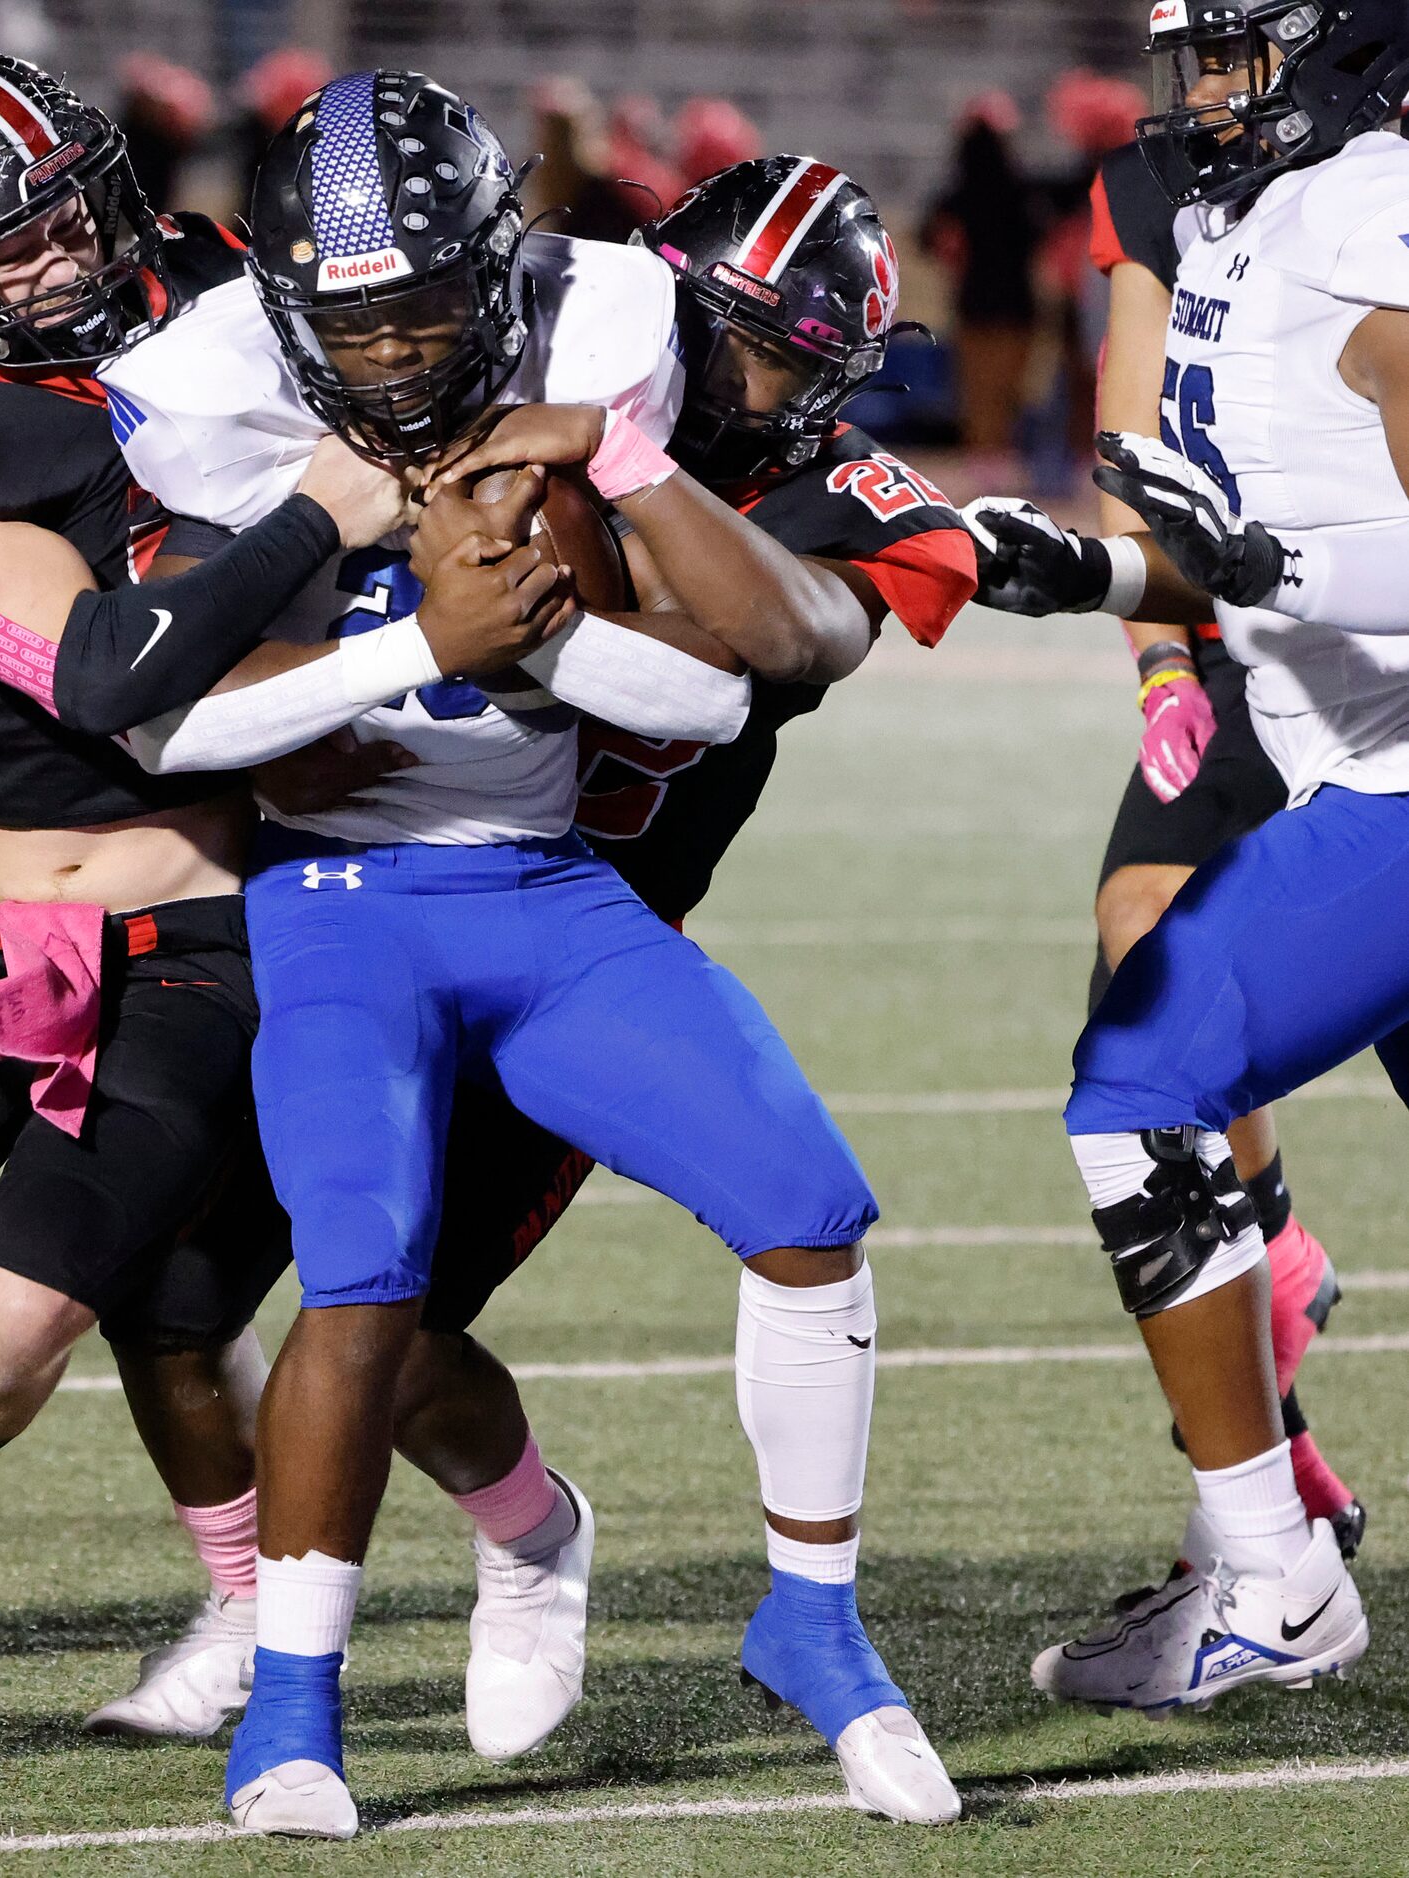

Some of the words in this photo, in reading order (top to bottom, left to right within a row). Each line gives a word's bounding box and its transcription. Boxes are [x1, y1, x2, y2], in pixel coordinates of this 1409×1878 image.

[27, 142, 85, 185] PANTHERS
[327, 254, 396, 280] Riddell
[712, 263, 782, 307] PANTHERS
[1172, 288, 1231, 343] SUMMIT
[8, 625, 43, 647] BATTLE
[0, 654, 33, 677] BATTLE
